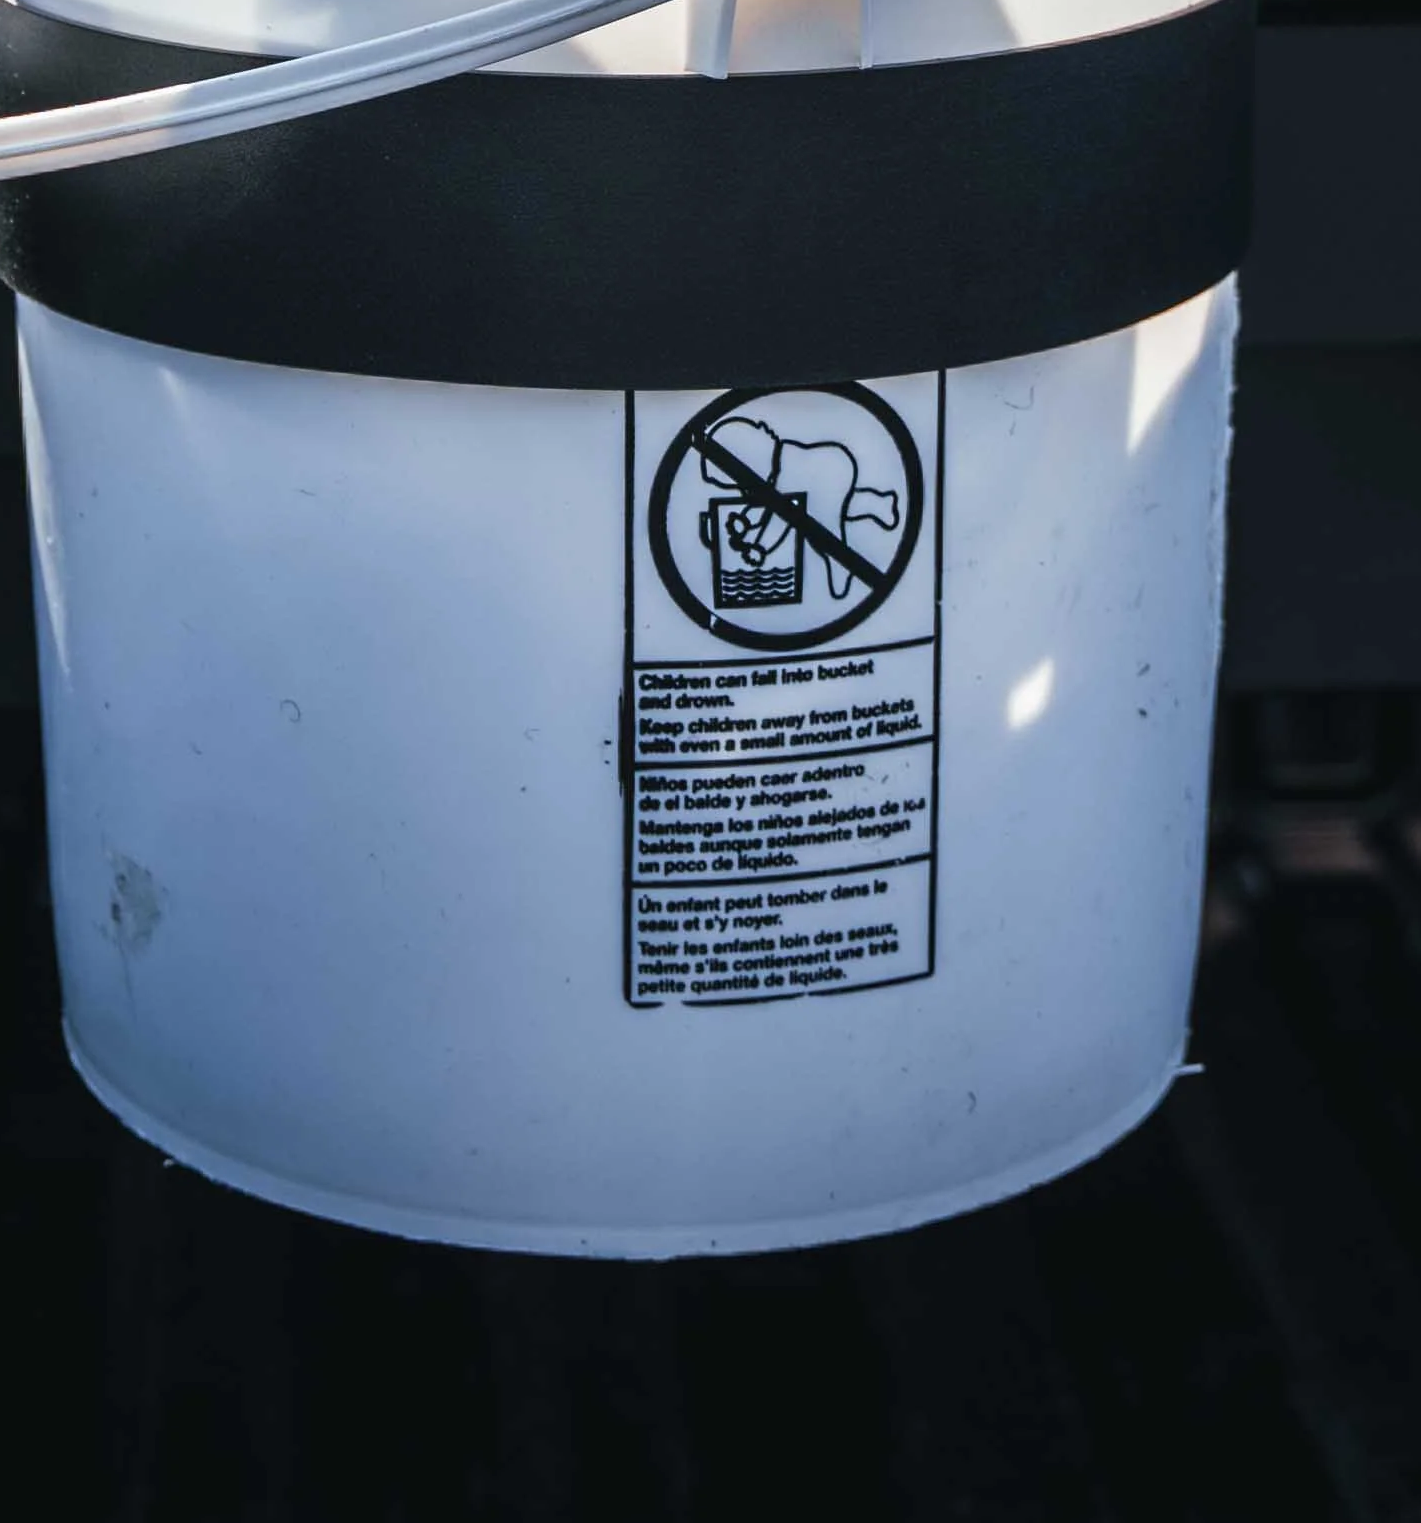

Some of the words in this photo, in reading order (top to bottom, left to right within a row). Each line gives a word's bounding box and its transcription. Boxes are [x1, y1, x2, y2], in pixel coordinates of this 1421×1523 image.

[639, 673, 711, 690] Children
[715, 675, 747, 688] can
[751, 670, 777, 686] fall
[781, 668, 813, 684] into
[818, 659, 874, 680] bucket
[639, 694, 671, 710] and
[675, 694, 735, 709] drown.
[639, 718, 683, 737] Keep
[688, 717, 757, 734] children
[761, 714, 805, 730] away
[809, 710, 847, 725] from
[852, 698, 914, 720] buckets
[639, 737, 675, 754] with
[679, 740, 720, 753] even
[724, 739, 736, 751] a
[740, 733, 785, 750] small
[789, 726, 852, 746] amount
[856, 722, 873, 738] of
[876, 714, 922, 736] liquid.
[639, 775, 687, 792] Niños
[692, 773, 755, 793] pueden
[761, 772, 797, 787] caer
[802, 764, 865, 782] adentro
[639, 795, 660, 811] de
[664, 795, 680, 810] el
[684, 793, 731, 810] balde
[736, 795, 746, 811] y
[750, 787, 832, 807] ahogarse.
[639, 819, 723, 838] Mantenga
[728, 818, 754, 832] los
[758, 813, 803, 830] niños
[808, 805, 875, 826] alejados
[880, 800, 899, 816] de
[639, 839, 695, 854] baldes
[699, 837, 762, 854] aunque
[767, 828, 852, 848] solamente
[857, 819, 911, 838] tengan
[639, 860, 659, 873] un
[664, 858, 707, 877] poco
[712, 855, 733, 871] de
[666, 896, 720, 913] enfant
[725, 894, 762, 913] peut
[767, 889, 827, 907] tomber
[831, 884, 870, 901] dans
[874, 879, 888, 894] le
[638, 918, 678, 932] seau
[683, 916, 700, 931] et
[705, 915, 728, 932] s'y
[733, 913, 782, 930] noyer.
[638, 941, 678, 956] Tenir
[683, 941, 708, 955] les
[713, 937, 775, 954] enfants
[780, 933, 809, 949] loin
[814, 930, 843, 946] des
[848, 923, 897, 941] seaux,
[638, 960, 690, 974] même
[695, 958, 728, 973] s'ils
[733, 949, 830, 971] contiennent
[835, 946, 864, 961] une
[869, 939, 899, 956] très
[638, 979, 685, 996] petite
[691, 974, 759, 994] quantité
[764, 972, 784, 987] de
[789, 966, 847, 987] liquide.
